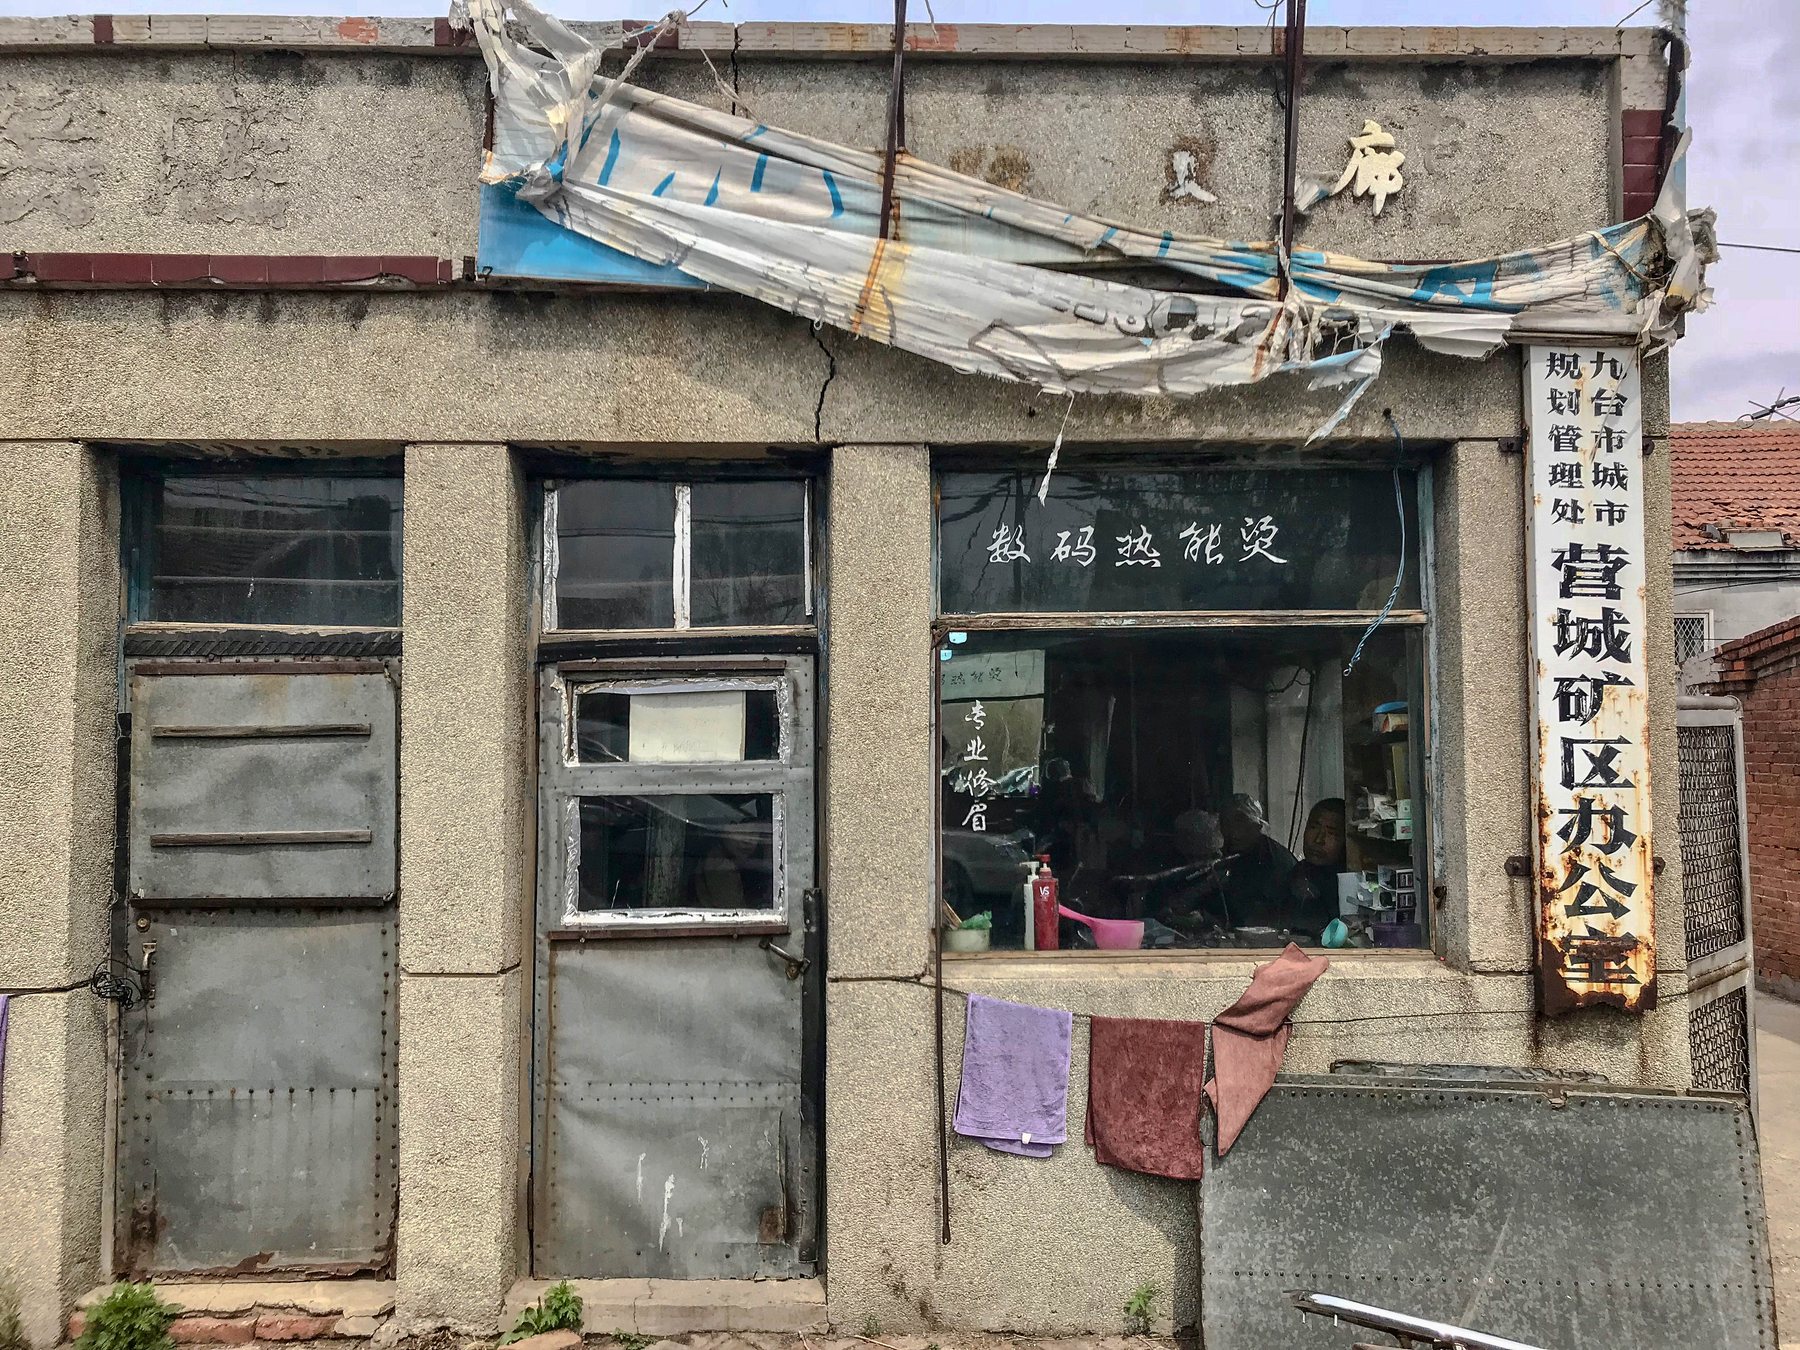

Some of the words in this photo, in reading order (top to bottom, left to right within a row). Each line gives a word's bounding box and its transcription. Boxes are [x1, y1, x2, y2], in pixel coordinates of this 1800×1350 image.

[1544, 351, 1586, 525] 规划管理处
[1590, 350, 1629, 527] 九台市城市
[986, 515, 1288, 568] 数码热能烫
[961, 699, 997, 833] 专业修眉
[1552, 542, 1640, 985] 营城矿区办公室
